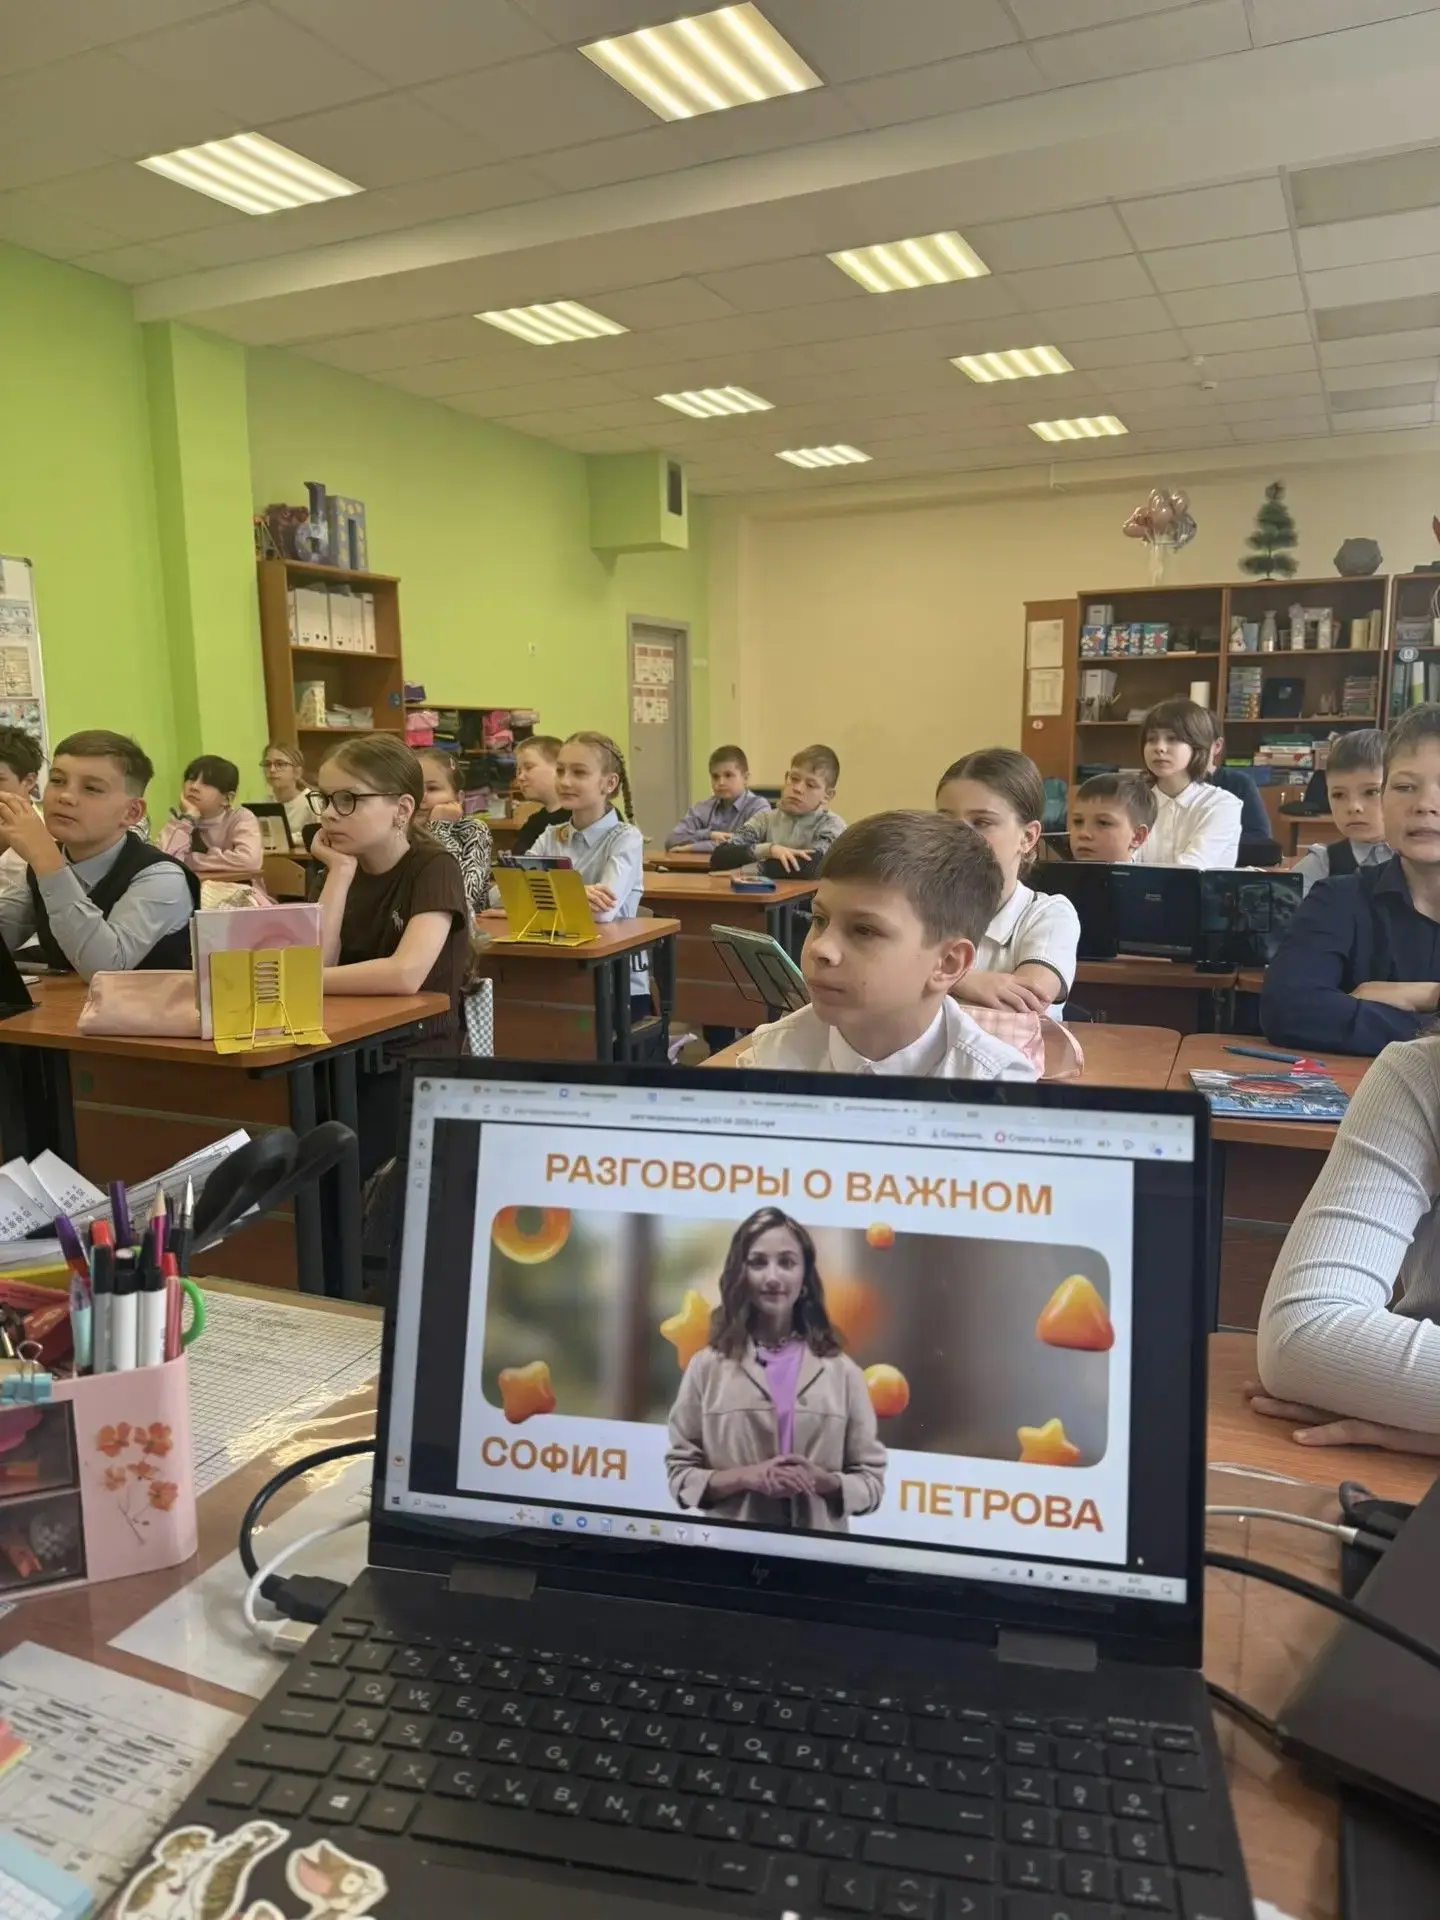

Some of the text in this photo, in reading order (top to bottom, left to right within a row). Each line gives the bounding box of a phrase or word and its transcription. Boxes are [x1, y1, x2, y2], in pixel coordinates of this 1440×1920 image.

[544, 1152, 1054, 1216] РАЗГОВОРЫ О ВАЖНОМ
[481, 1435, 628, 1481] СОФИЯ
[898, 1478, 1105, 1533] ПЕТРОВА
[408, 1656, 422, 1667] 2
[498, 1669, 510, 1679] 4
[542, 1674, 556, 1686] 5
[364, 1682, 382, 1696] Q
[588, 1681, 602, 1693] 6
[636, 1688, 648, 1699] 7
[408, 1688, 430, 1701] W
[682, 1694, 696, 1707] 8
[456, 1695, 472, 1708] E
[731, 1700, 744, 1712] 9
[501, 1702, 518, 1715] R
[553, 1709, 566, 1721] T
[353, 1717, 369, 1730] A
[599, 1717, 615, 1729] Y
[401, 1724, 417, 1737] S
[446, 1730, 464, 1744] D
[645, 1724, 663, 1737] U
[496, 1738, 513, 1751] F
[744, 1738, 762, 1751] O
[796, 1745, 812, 1757] P
[545, 1746, 562, 1759] G
[353, 1755, 372, 1769] Z
[595, 1753, 612, 1767] H
[403, 1764, 423, 1778] X
[645, 1762, 661, 1775] J
[453, 1771, 472, 1785] C
[696, 1768, 713, 1783] K
[504, 1778, 522, 1793] V
[749, 1776, 762, 1790] L
[1021, 1778, 1034, 1790] 7
[553, 1786, 571, 1801] B
[605, 1795, 624, 1809] N
[656, 1803, 678, 1818] M
